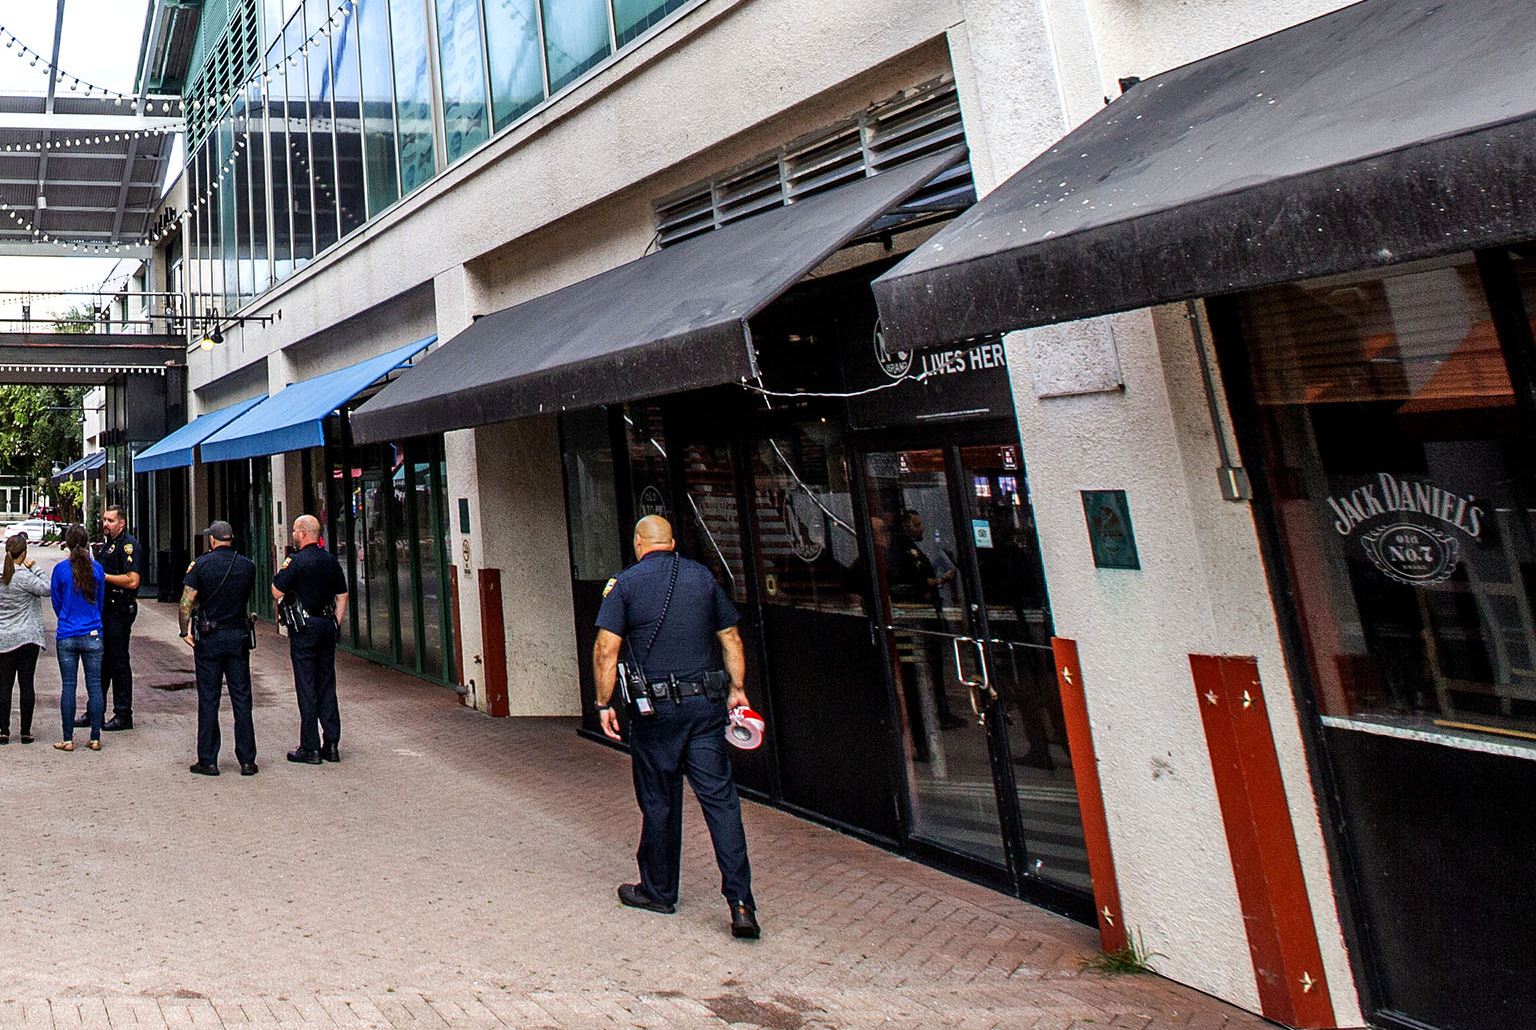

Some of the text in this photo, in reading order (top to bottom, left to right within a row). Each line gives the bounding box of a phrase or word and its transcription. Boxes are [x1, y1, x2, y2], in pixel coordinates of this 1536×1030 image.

[884, 360, 909, 375] BRAND
[921, 349, 966, 377] LIVES
[1325, 472, 1484, 539] JACK DANIEL'S
